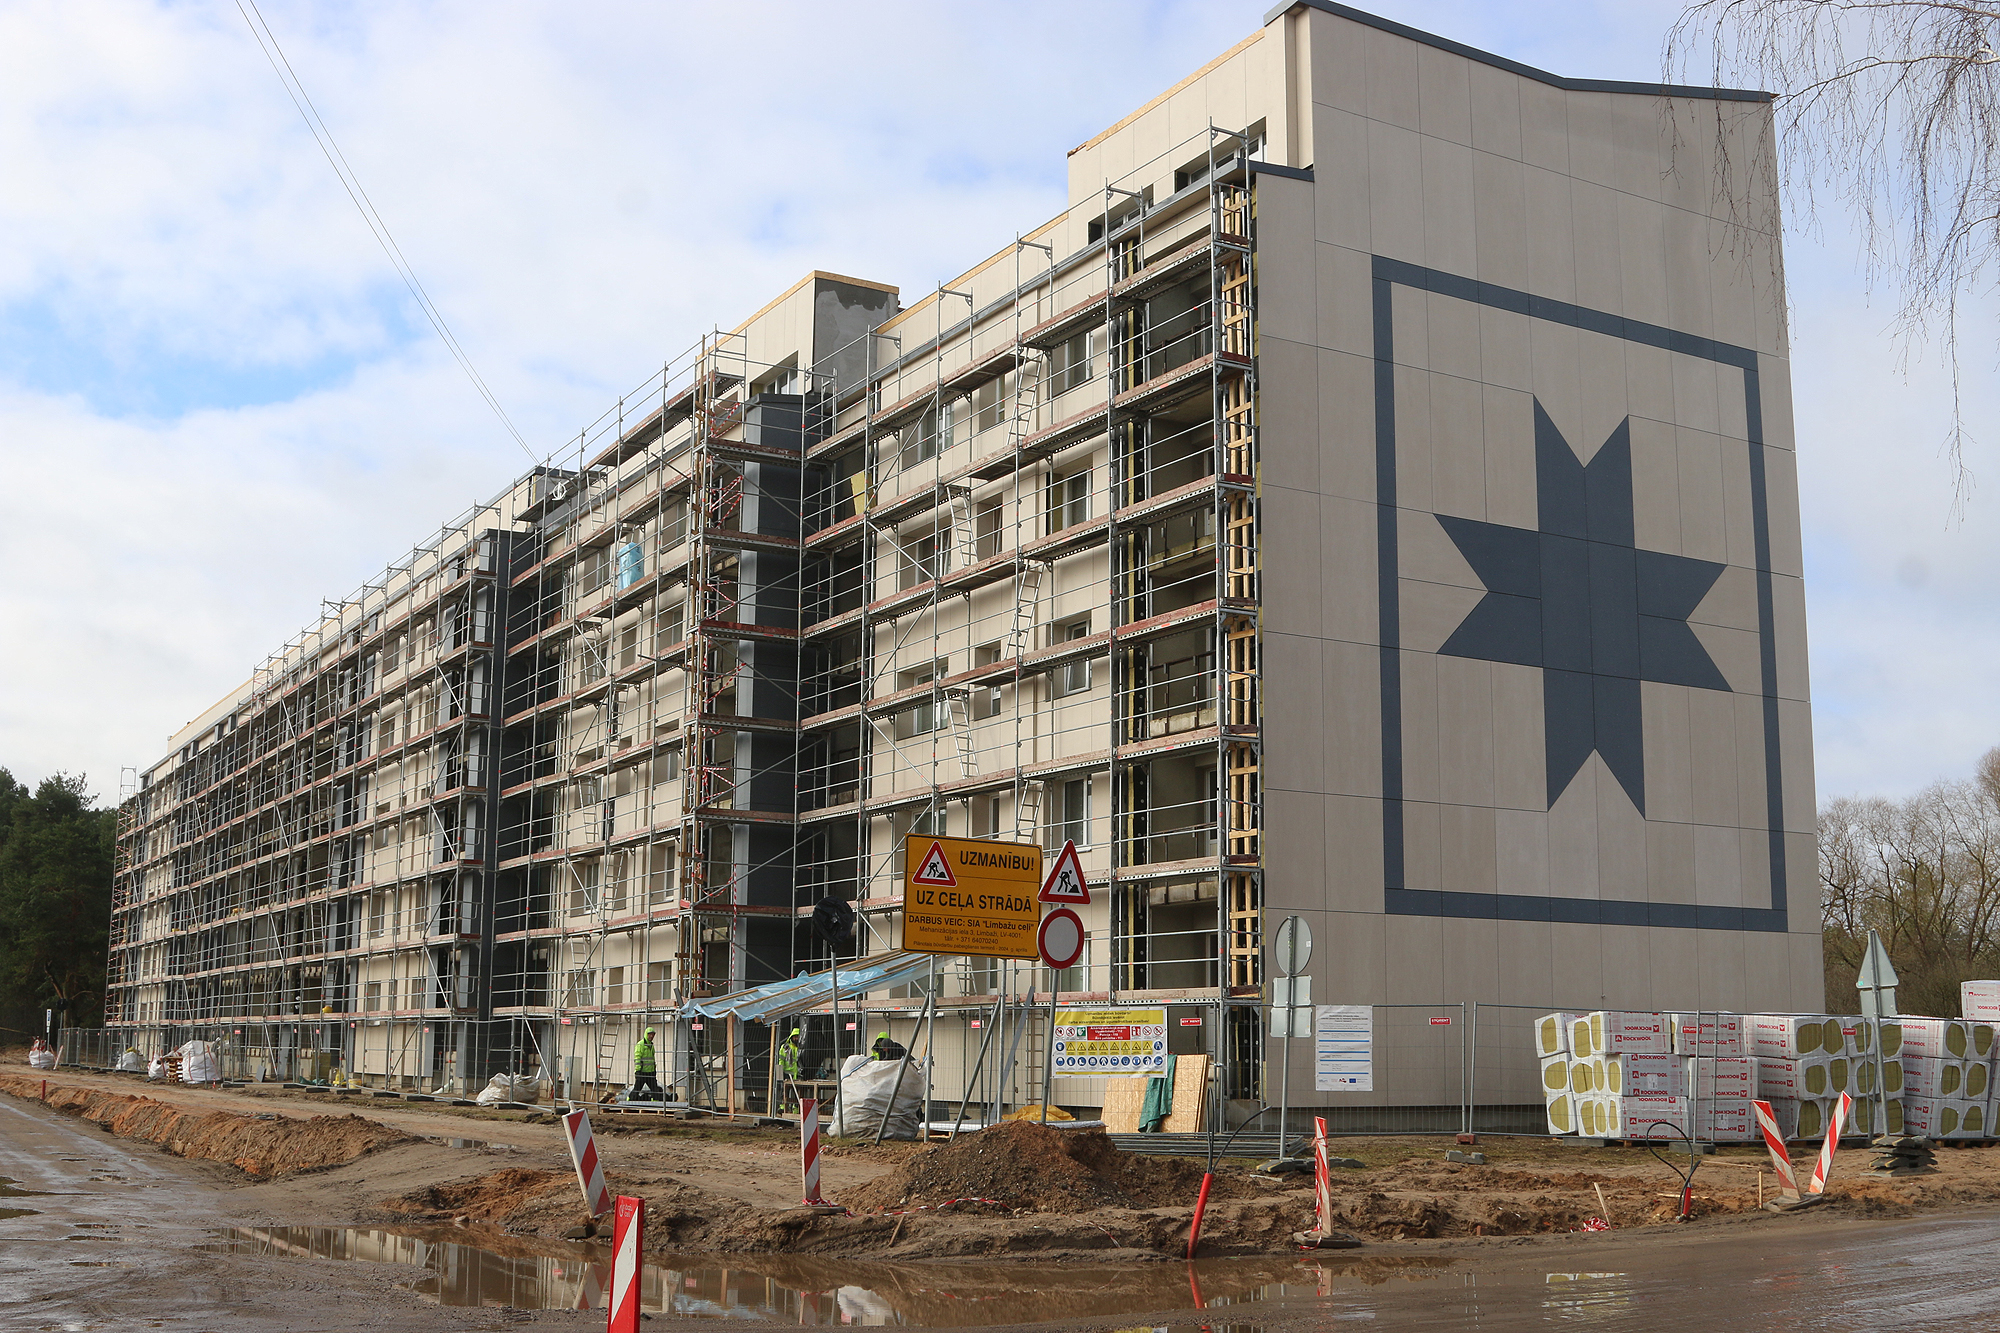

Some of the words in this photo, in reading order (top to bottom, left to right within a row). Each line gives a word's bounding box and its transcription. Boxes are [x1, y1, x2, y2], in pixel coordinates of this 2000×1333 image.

[960, 850, 1034, 871] UZMANĪBU!
[917, 890, 934, 905] UZ
[939, 892, 974, 911] CEĻA
[979, 895, 1032, 912] STRĀDĀ
[909, 915, 942, 924] DARBUS
[944, 918, 965, 926] VEIC:
[967, 919, 980, 927] SIA
[983, 921, 1016, 930] "Limbažu
[1018, 923, 1034, 932] ceļi"
[920, 926, 958, 935] Mehanizācijas
